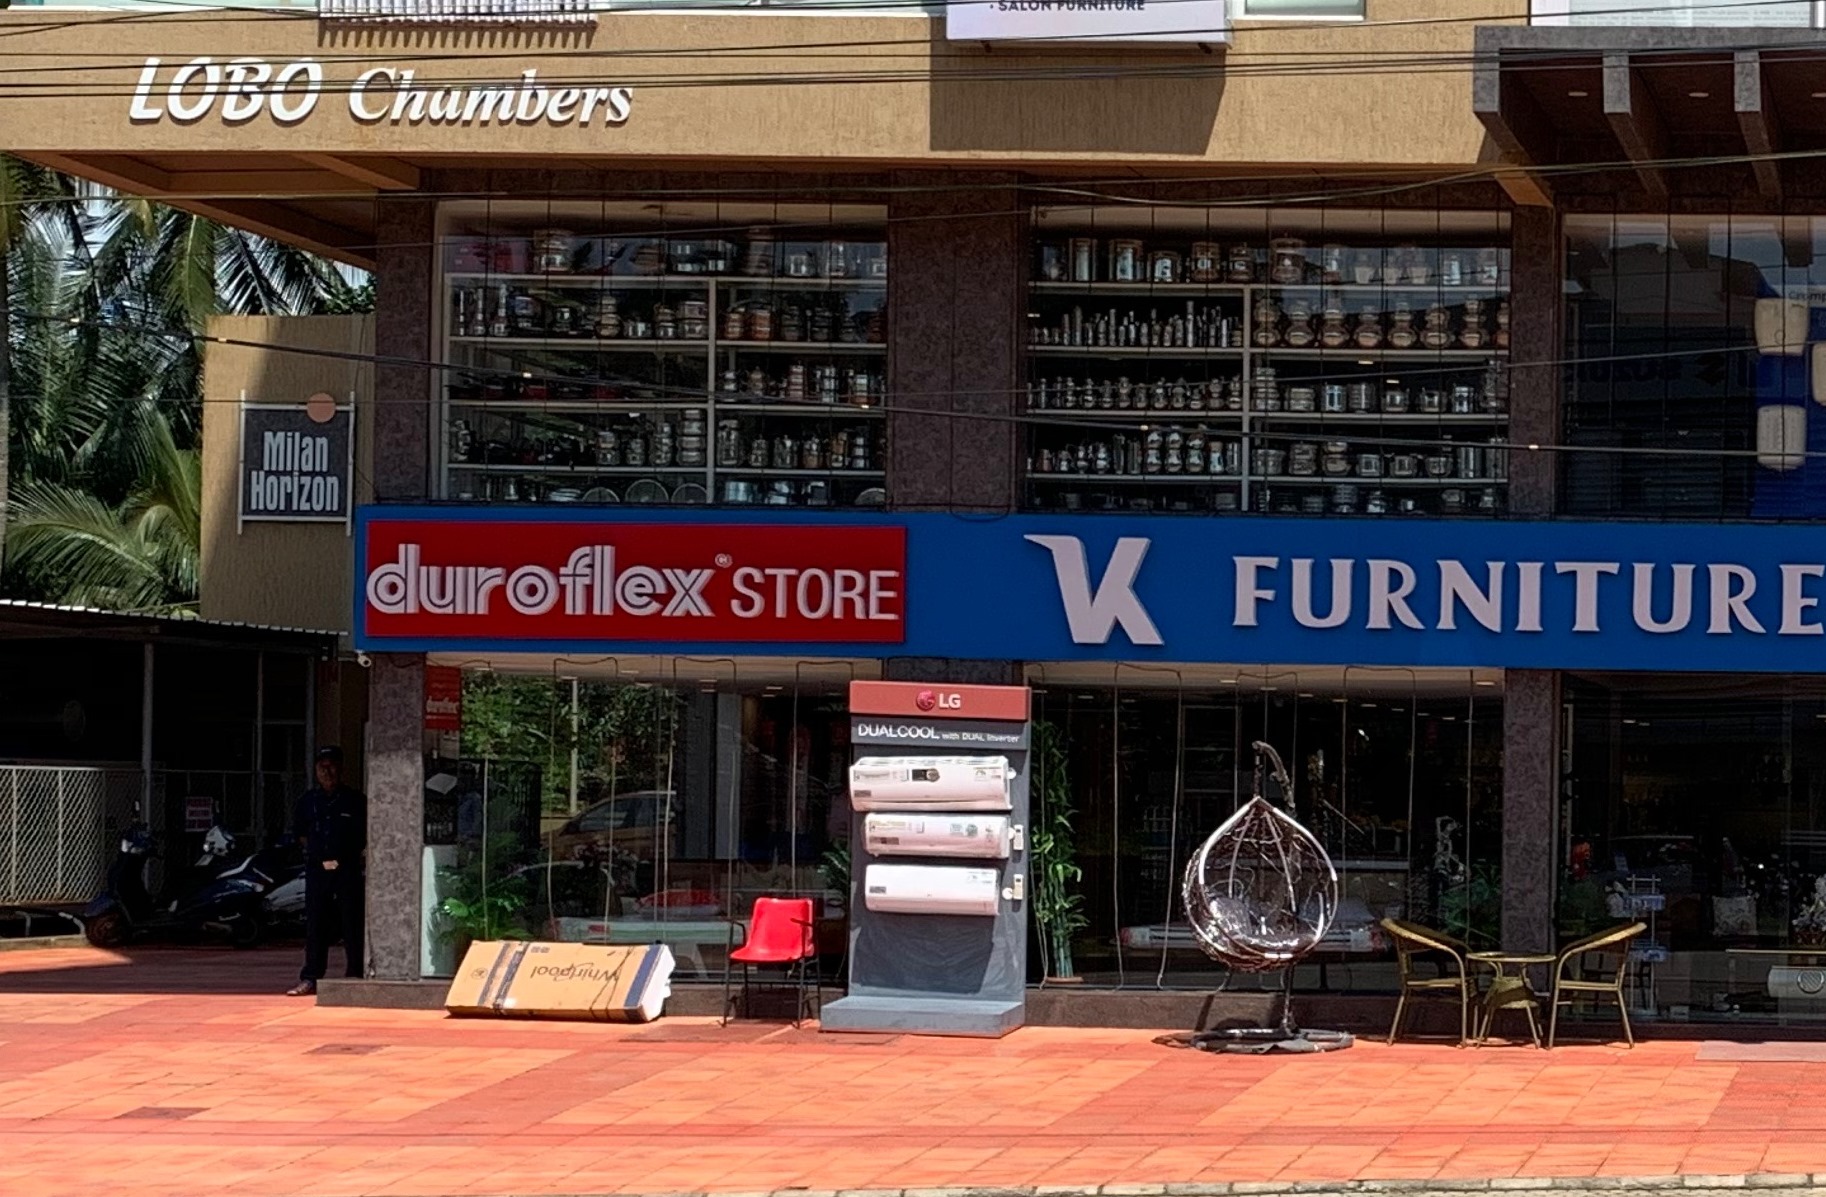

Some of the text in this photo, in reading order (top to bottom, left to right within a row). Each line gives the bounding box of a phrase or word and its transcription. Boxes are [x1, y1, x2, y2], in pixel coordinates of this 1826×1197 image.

[998, 0, 1145, 11] SALON FURNITURE
[129, 56, 633, 125] LOBO Chambers
[263, 430, 329, 473] Milan
[250, 470, 339, 512] Horizon
[366, 543, 901, 621] duroflex STORE
[1232, 556, 1826, 636] FURNITURE
[938, 693, 962, 709] LG
[858, 723, 1020, 743] DUALCOOL with DUAL Inverter
[529, 962, 620, 983] Whirlpool
